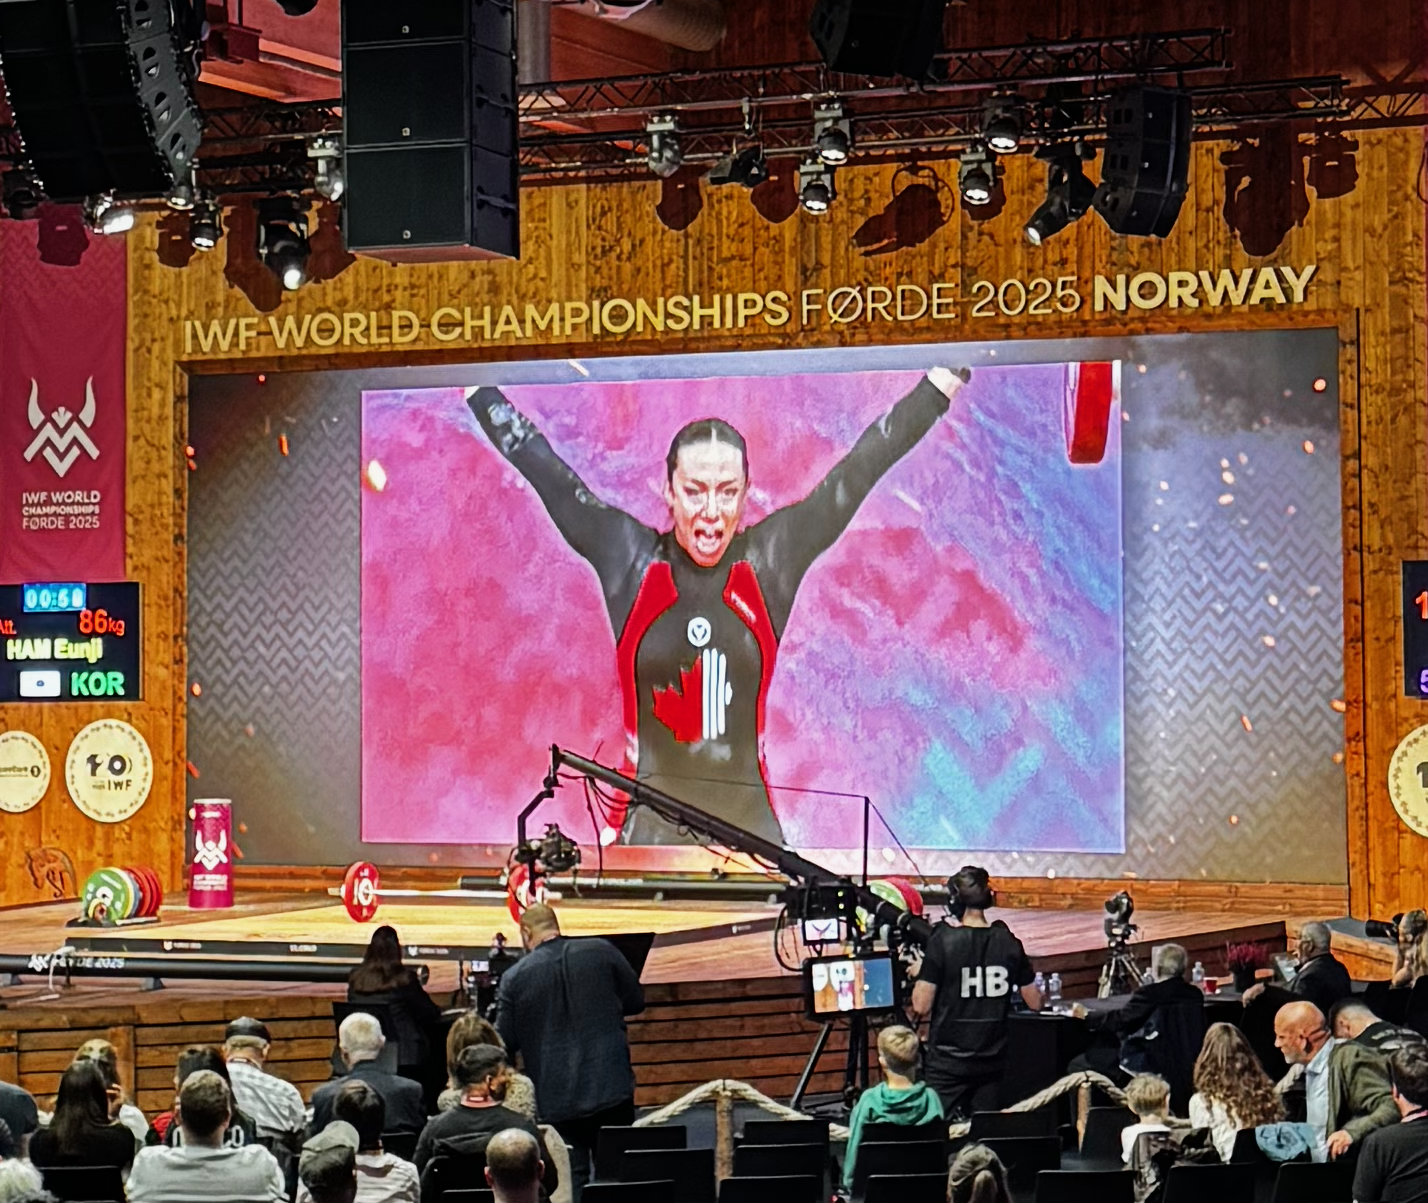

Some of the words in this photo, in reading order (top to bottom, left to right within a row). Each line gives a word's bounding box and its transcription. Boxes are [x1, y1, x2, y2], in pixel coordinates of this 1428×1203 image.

[183, 317, 257, 354] IWF
[268, 310, 420, 348] WORLD
[430, 290, 790, 341] CHAMPIONSHIPS
[801, 282, 956, 325] FØRDE
[972, 275, 1082, 317] 2025
[1095, 265, 1317, 311] NORWAY
[22, 491, 47, 505] IWF
[51, 490, 100, 503] WORLD
[22, 505, 100, 515] CHAMPIONSHIPS
[22, 516, 65, 529] FØRDE
[69, 515, 100, 528] 2025
[1416, 592, 1428, 619] 1
[7, 639, 50, 659] HAM
[54, 638, 103, 663] Eunji
[71, 671, 125, 696] KOR
[107, 781, 132, 791] IWF
[961, 966, 1009, 998] HB
